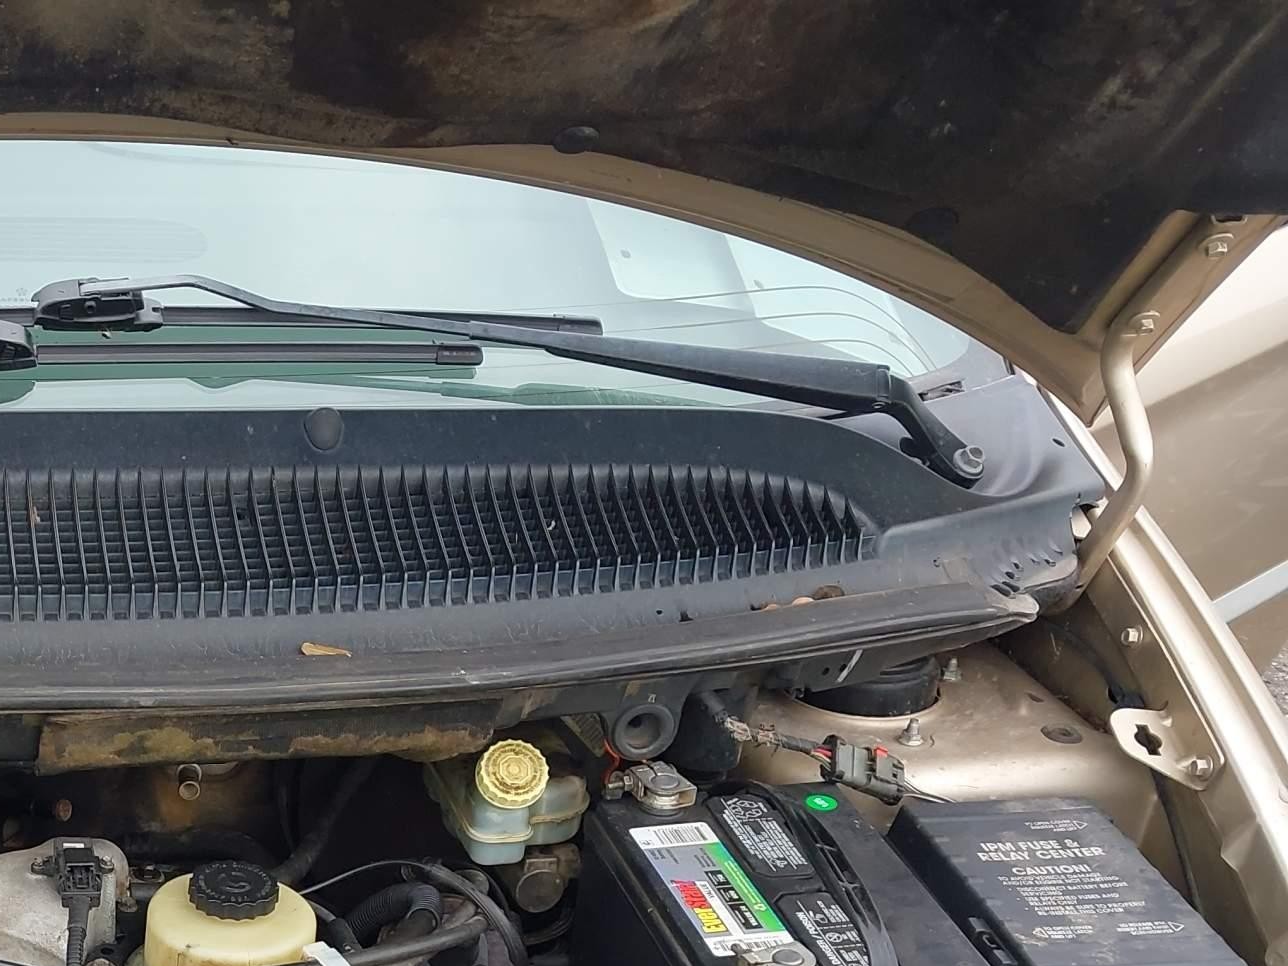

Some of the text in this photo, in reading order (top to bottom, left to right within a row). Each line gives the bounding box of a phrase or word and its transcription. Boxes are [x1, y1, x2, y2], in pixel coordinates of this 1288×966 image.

[980, 839, 1080, 851] IPM FUSE &
[977, 847, 1106, 862] RELAY CENTER
[1012, 864, 1092, 875] CAUTION!
